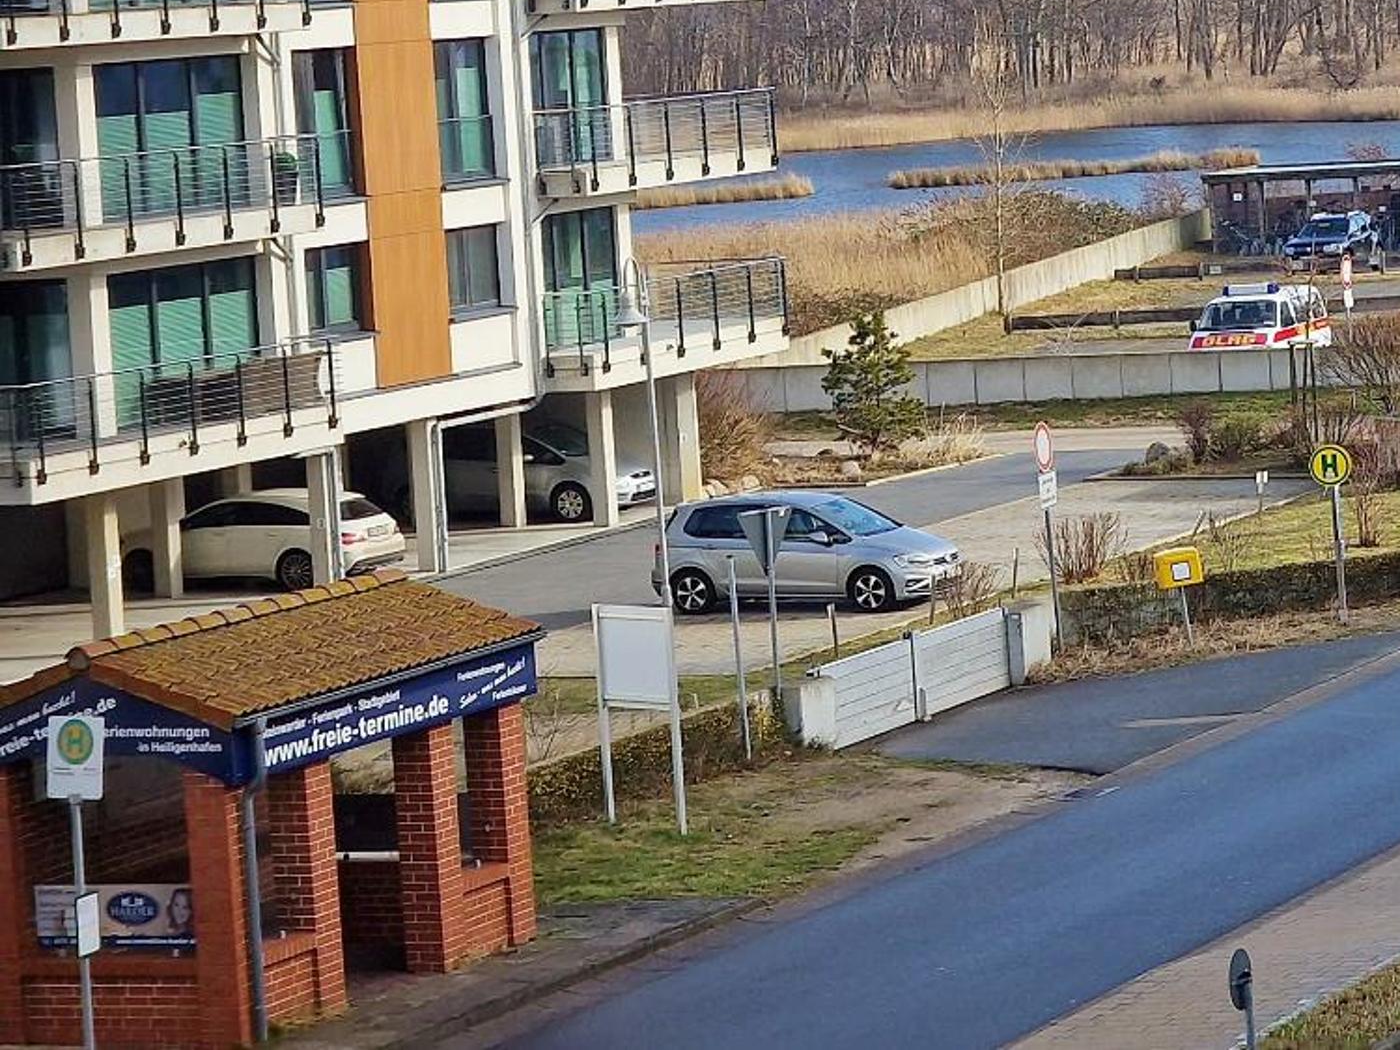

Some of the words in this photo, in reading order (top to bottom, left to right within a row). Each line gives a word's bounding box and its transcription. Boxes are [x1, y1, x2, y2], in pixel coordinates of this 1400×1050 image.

[1321, 454, 1339, 479] H
[103, 724, 210, 741] erienwohnungen
[264, 694, 449, 767] www.freie-termine.de
[151, 741, 222, 754] Heiligenhafen
